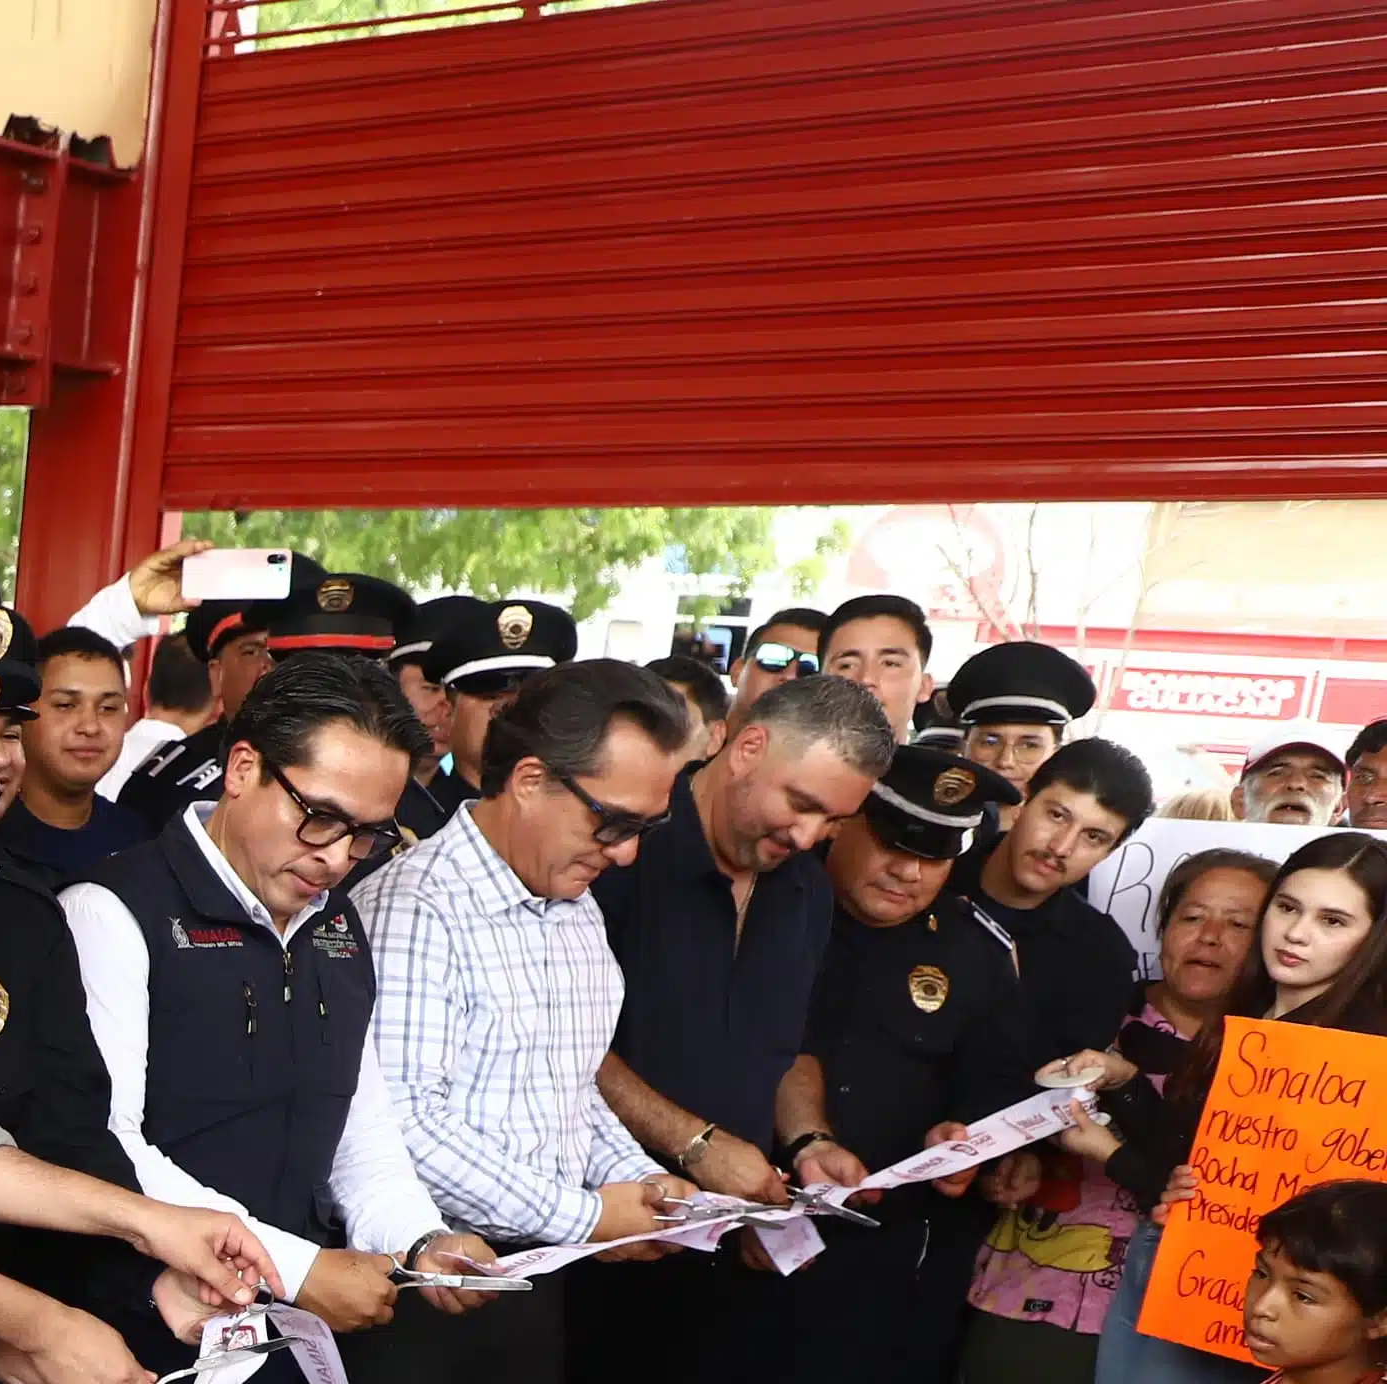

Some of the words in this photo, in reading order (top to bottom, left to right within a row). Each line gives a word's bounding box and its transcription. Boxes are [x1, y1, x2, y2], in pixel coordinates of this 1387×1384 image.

[1120, 671, 1296, 700] BOMBEROS
[1227, 1031, 1367, 1109] Sinaloa
[1205, 1108, 1299, 1152] nuestro
[1190, 1146, 1259, 1197] Rocha
